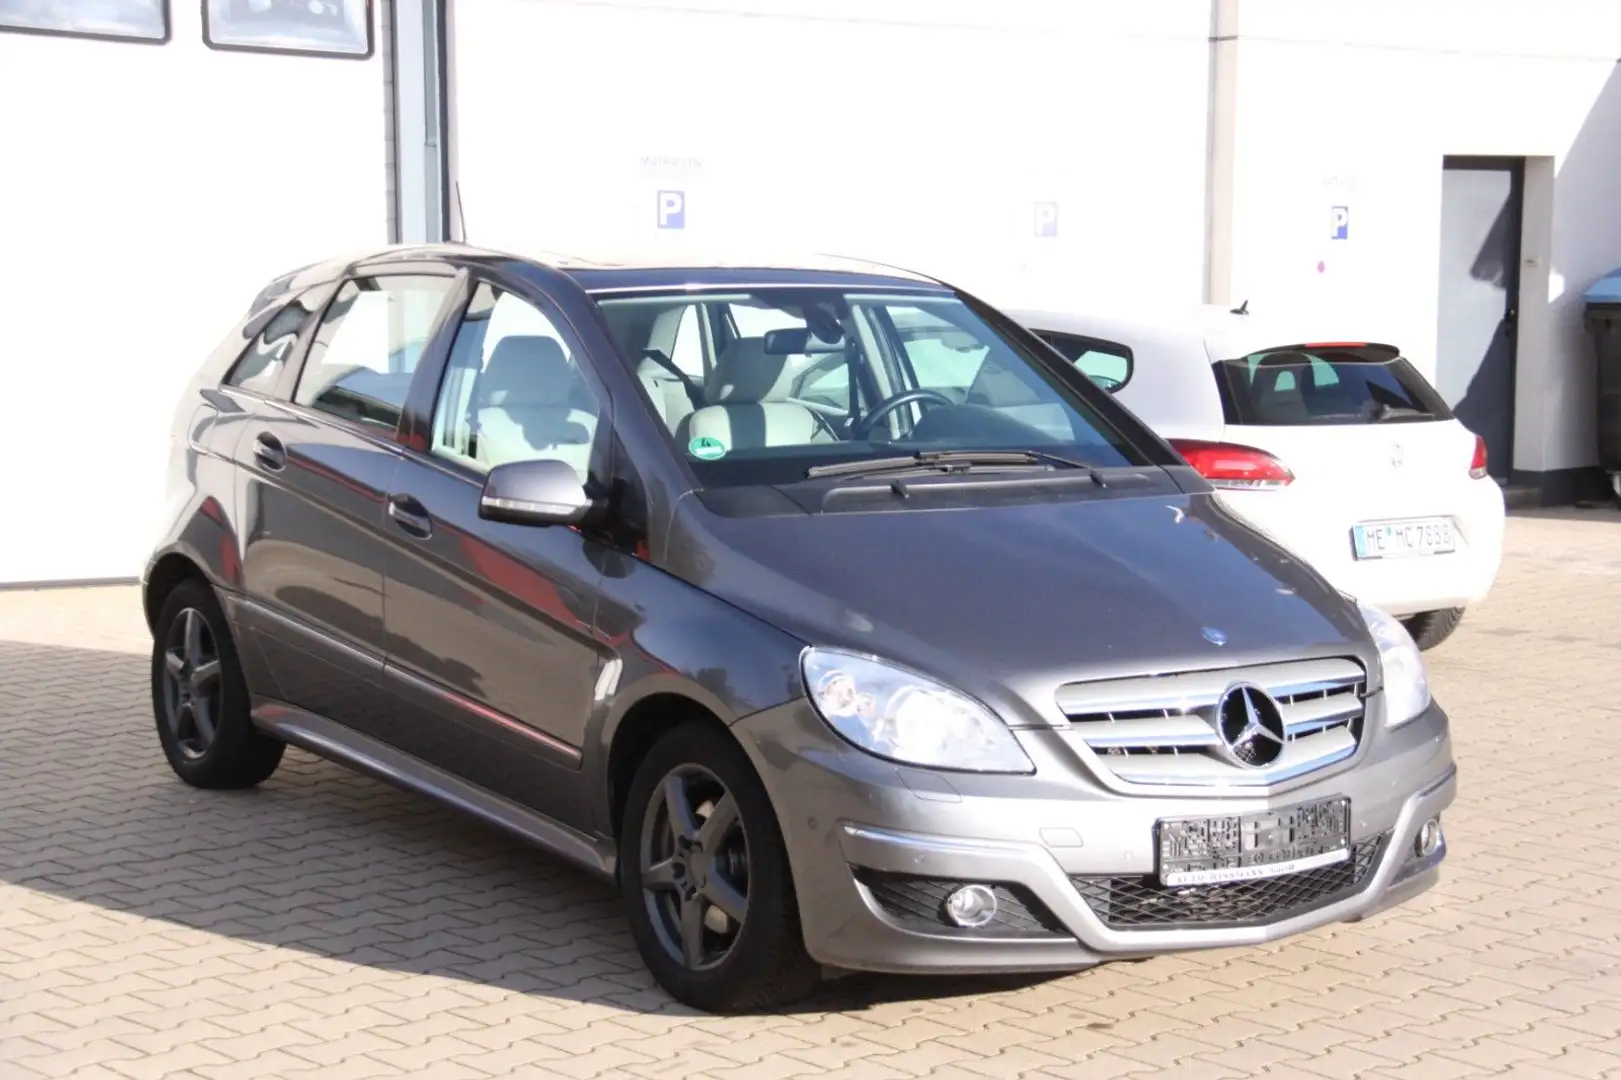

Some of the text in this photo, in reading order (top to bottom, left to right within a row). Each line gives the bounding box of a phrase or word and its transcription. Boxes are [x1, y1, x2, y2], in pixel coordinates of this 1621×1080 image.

[660, 192, 682, 226] P
[1035, 203, 1056, 236] P
[1331, 208, 1348, 237] P
